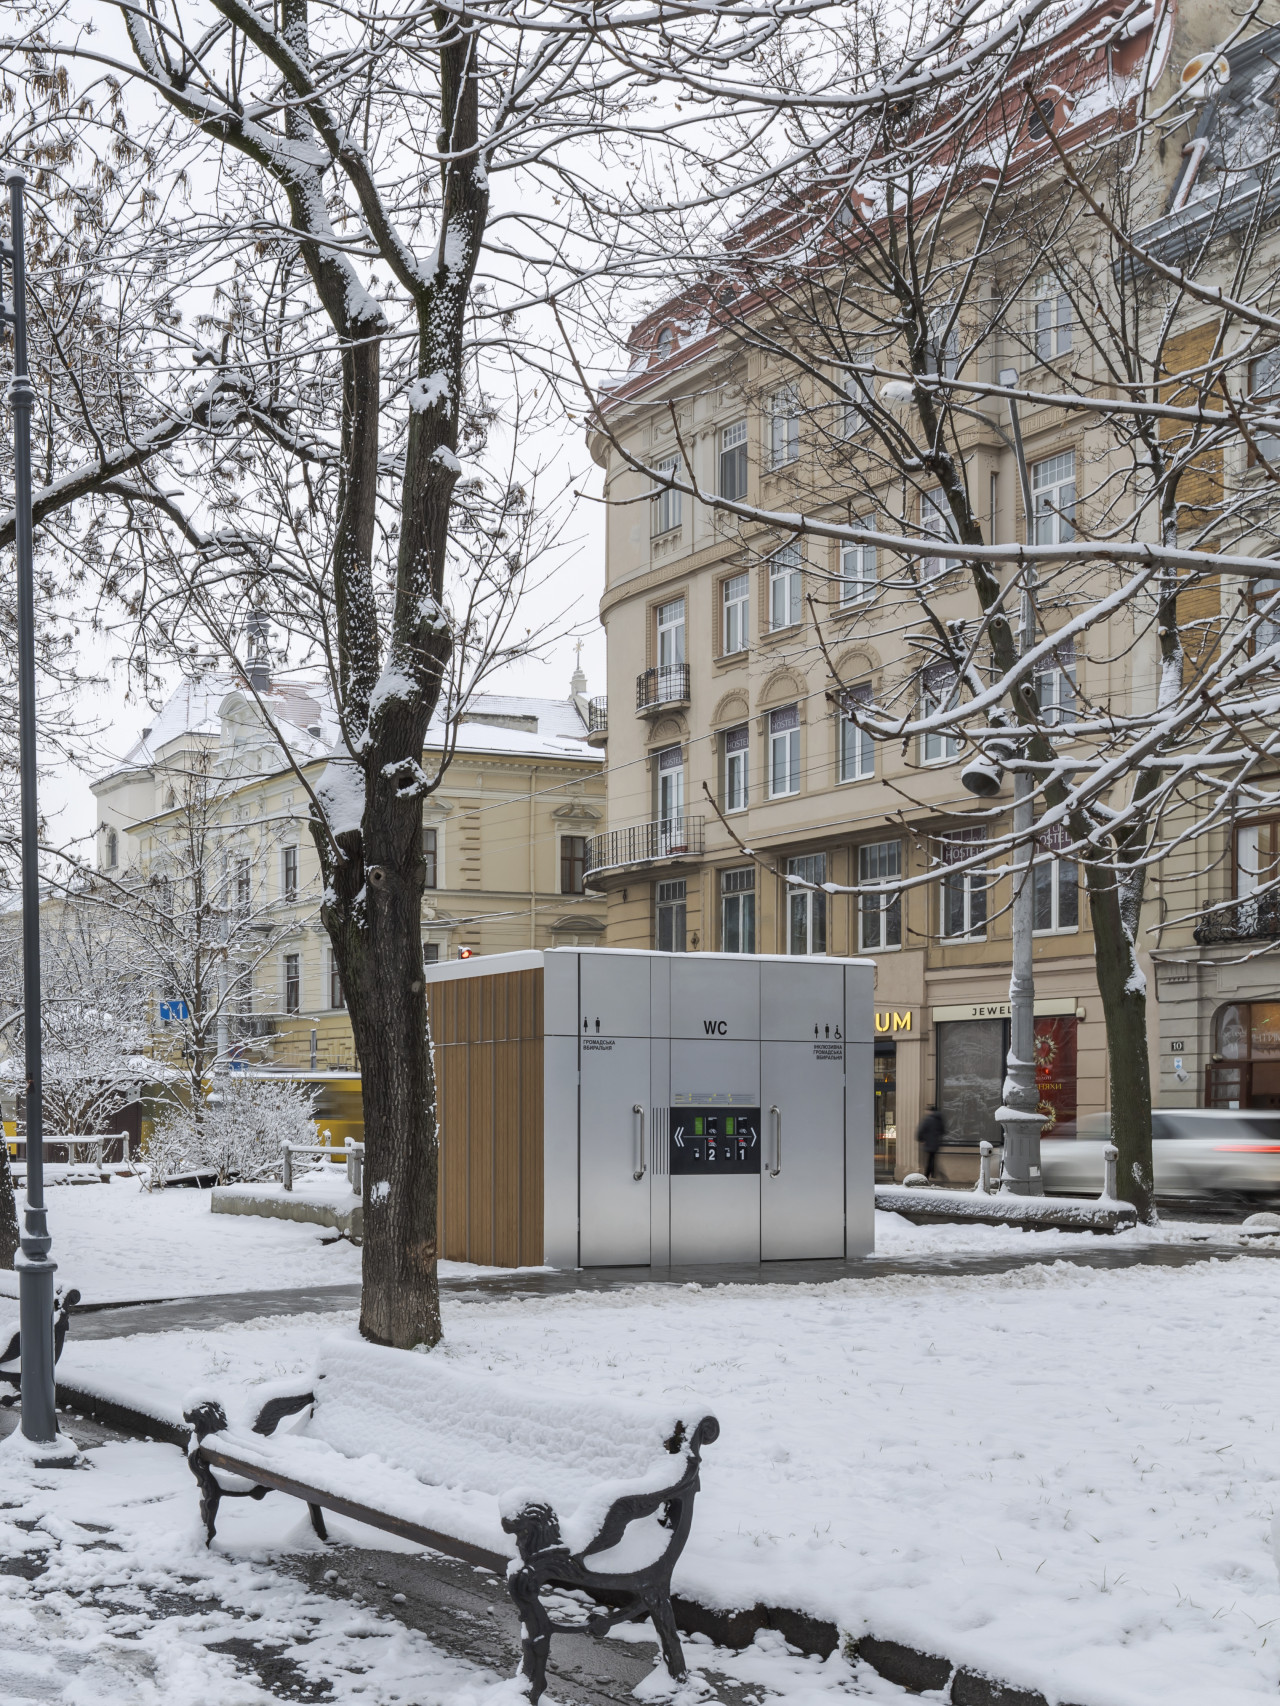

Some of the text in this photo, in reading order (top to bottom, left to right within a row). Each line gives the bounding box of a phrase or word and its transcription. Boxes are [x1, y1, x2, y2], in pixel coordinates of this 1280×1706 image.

[772, 718, 796, 730] HOSTEL
[728, 737, 749, 750] HOSTEL
[661, 757, 682, 768] HOSTEL
[1039, 831, 1071, 845] OSTEL
[972, 1006, 1011, 1016] JEWEL
[703, 1020, 727, 1035] WC
[875, 1011, 912, 1032] UM
[1172, 1042, 1182, 1050] 10
[708, 1149, 745, 1160] 2 1
